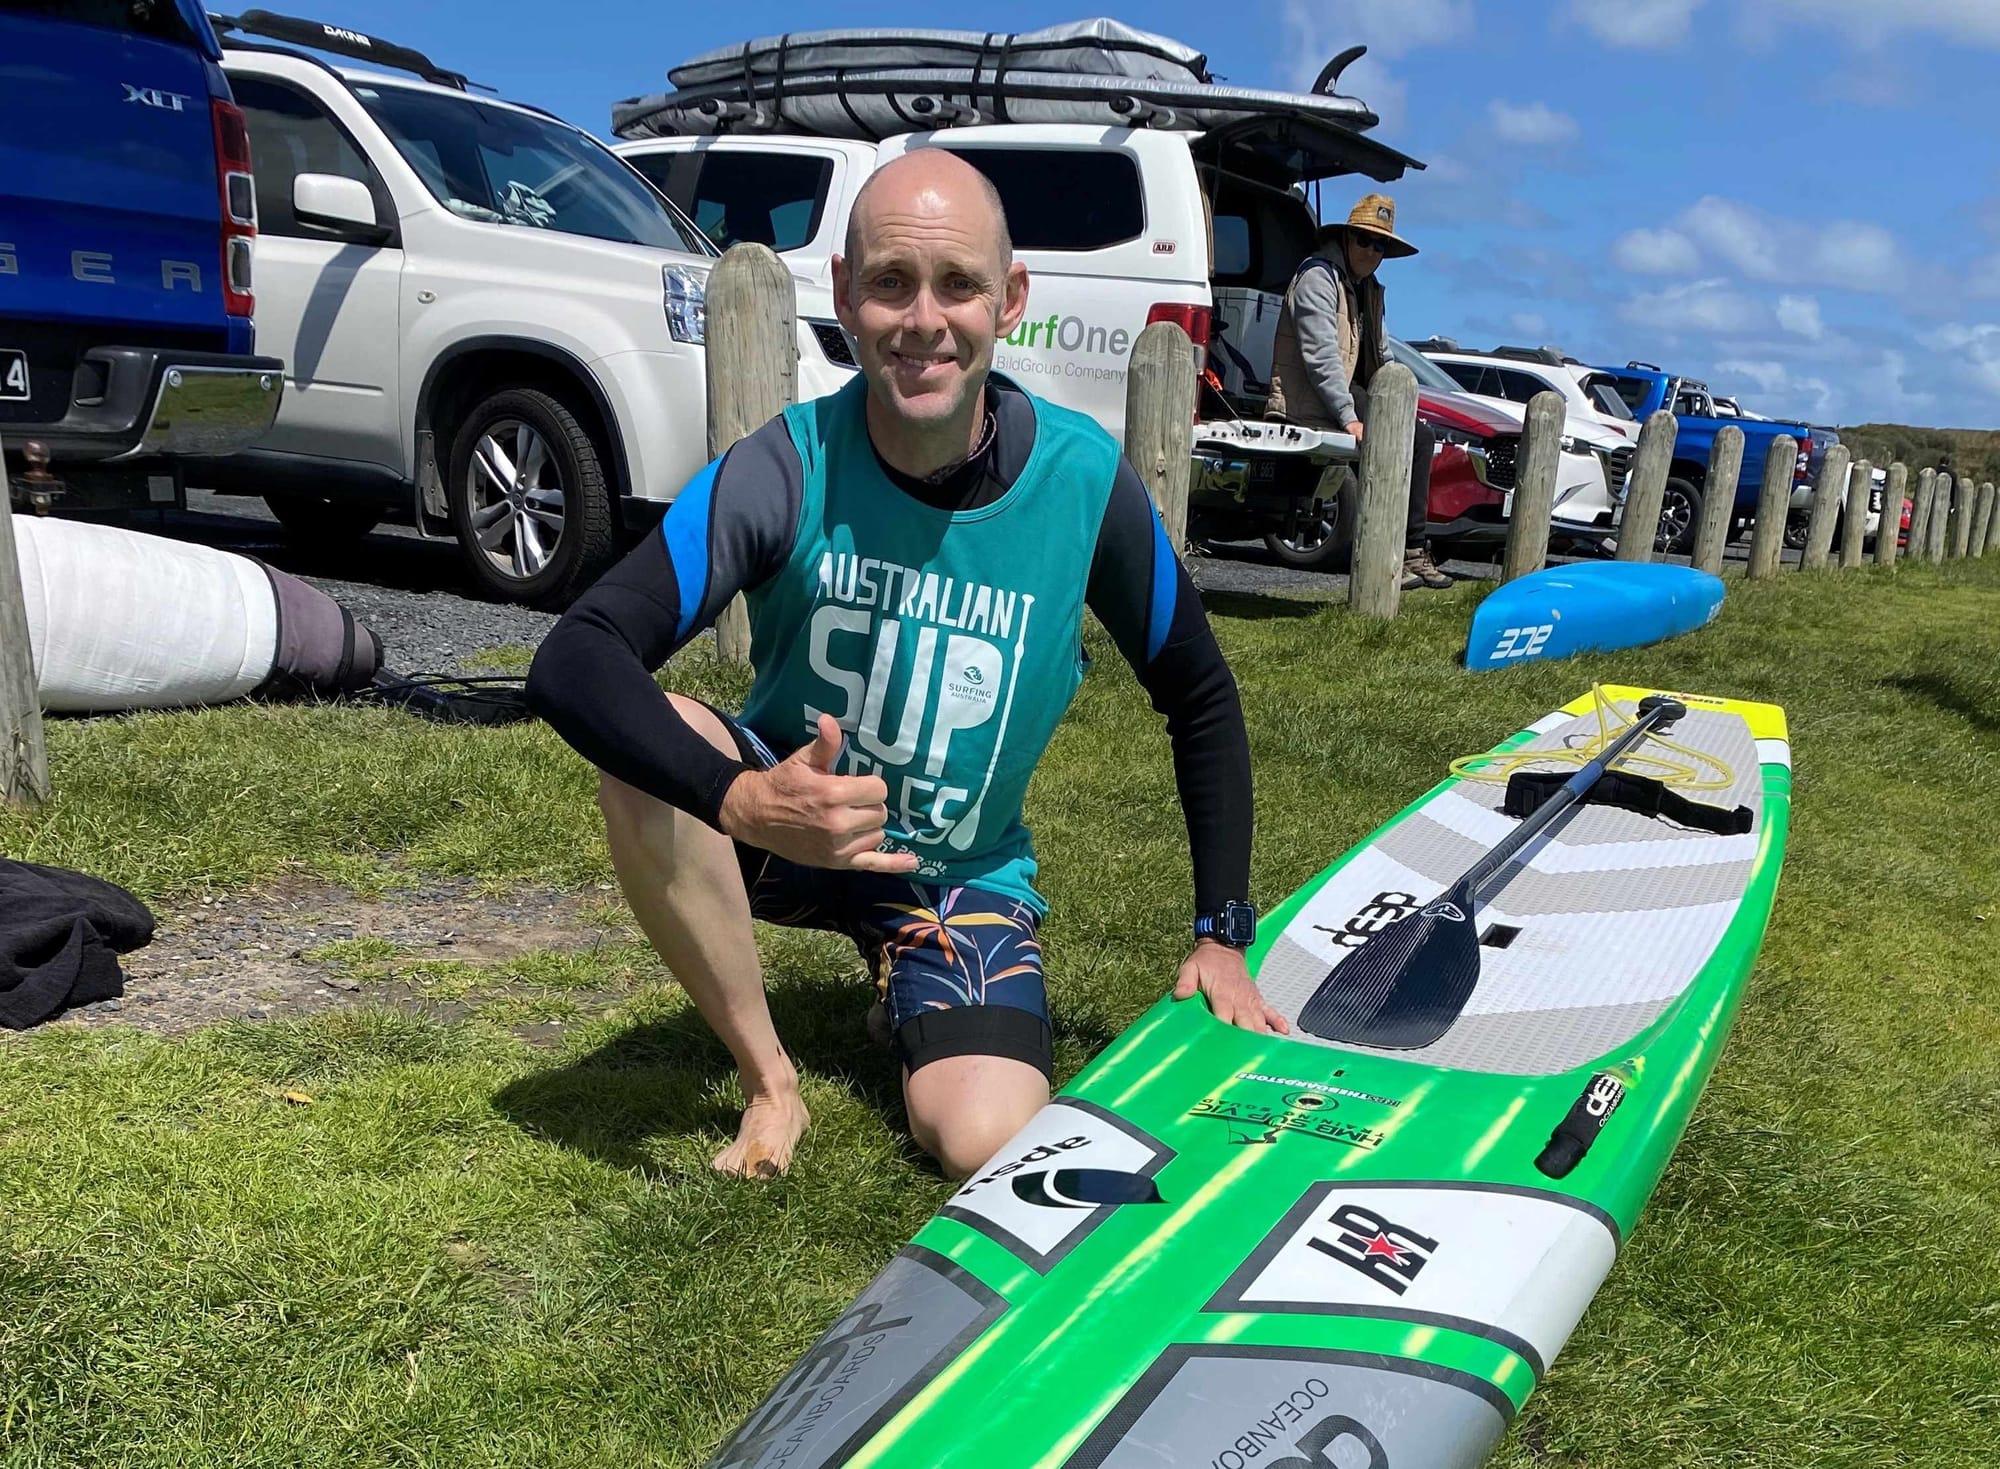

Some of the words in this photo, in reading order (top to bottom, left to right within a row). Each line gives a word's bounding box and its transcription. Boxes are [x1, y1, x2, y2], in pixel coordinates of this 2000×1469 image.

[121, 82, 191, 112] XLT
[994, 314, 1129, 355] urfOne
[996, 355, 1061, 376] BildGroup
[1064, 362, 1126, 384] Company
[816, 552, 1016, 639] AUSTRALIAN
[803, 605, 1003, 778] SUP
[949, 683, 992, 699] SURFING
[951, 692, 987, 704] AUSTRALIA
[1315, 1123, 1385, 1147] HMB
